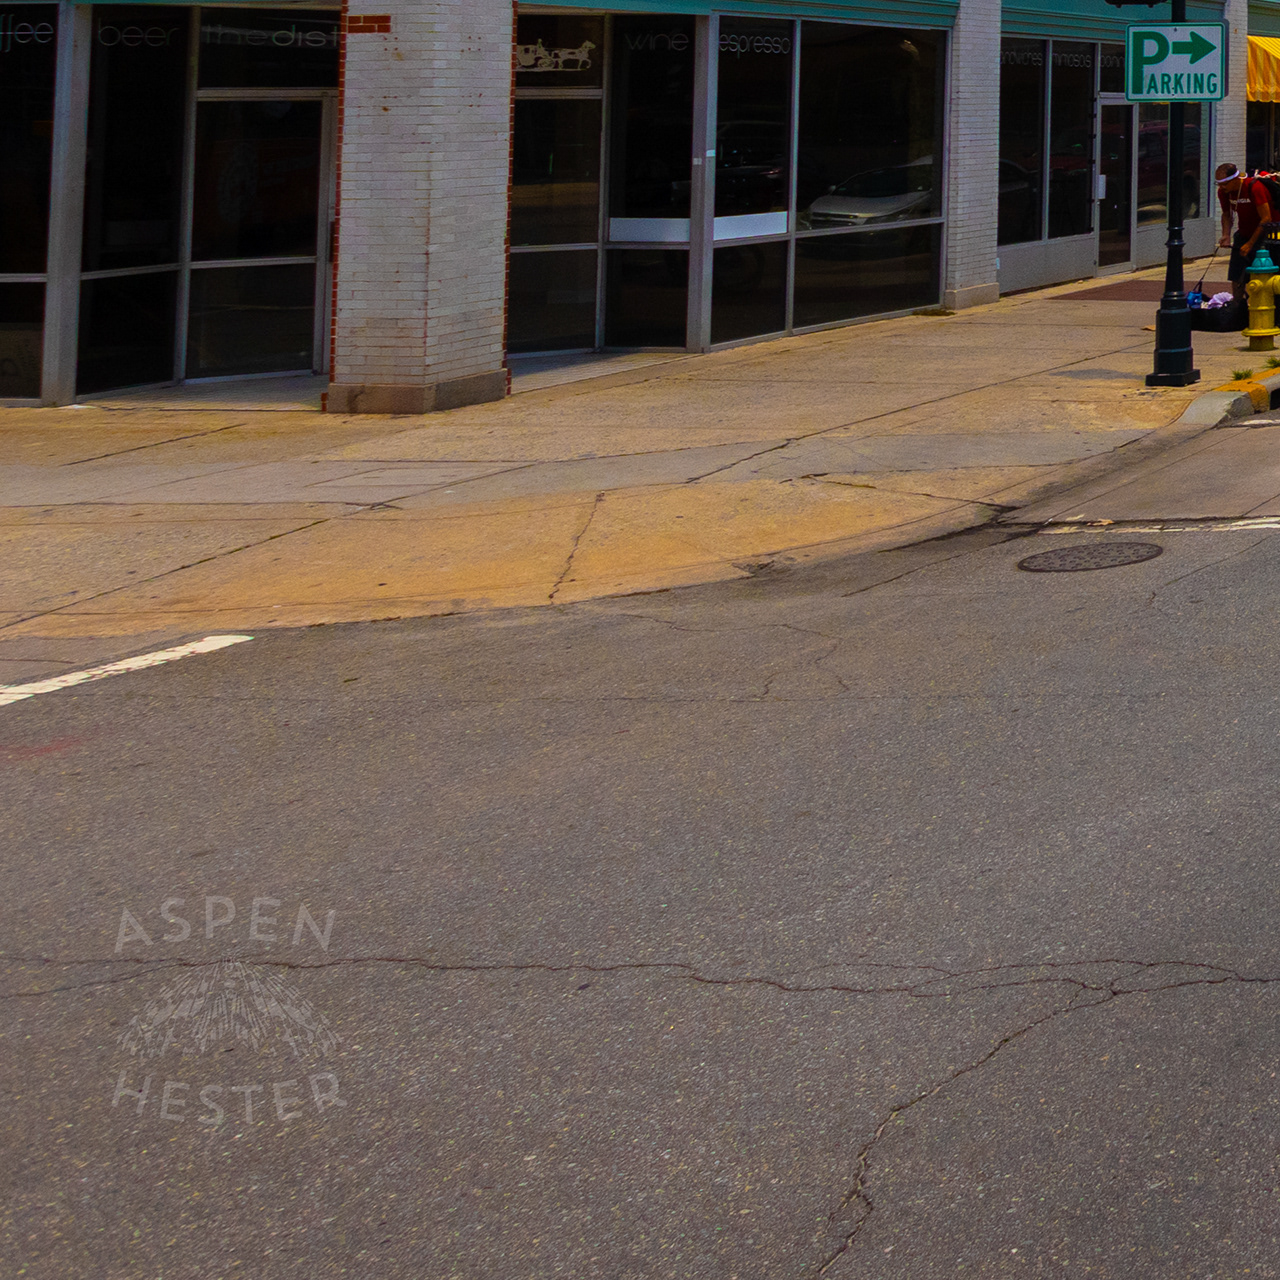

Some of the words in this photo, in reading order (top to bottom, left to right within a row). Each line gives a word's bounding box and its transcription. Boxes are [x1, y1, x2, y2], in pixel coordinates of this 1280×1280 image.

[99, 18, 180, 47] beer
[624, 30, 690, 51] wine
[719, 33, 791, 60] espresso
